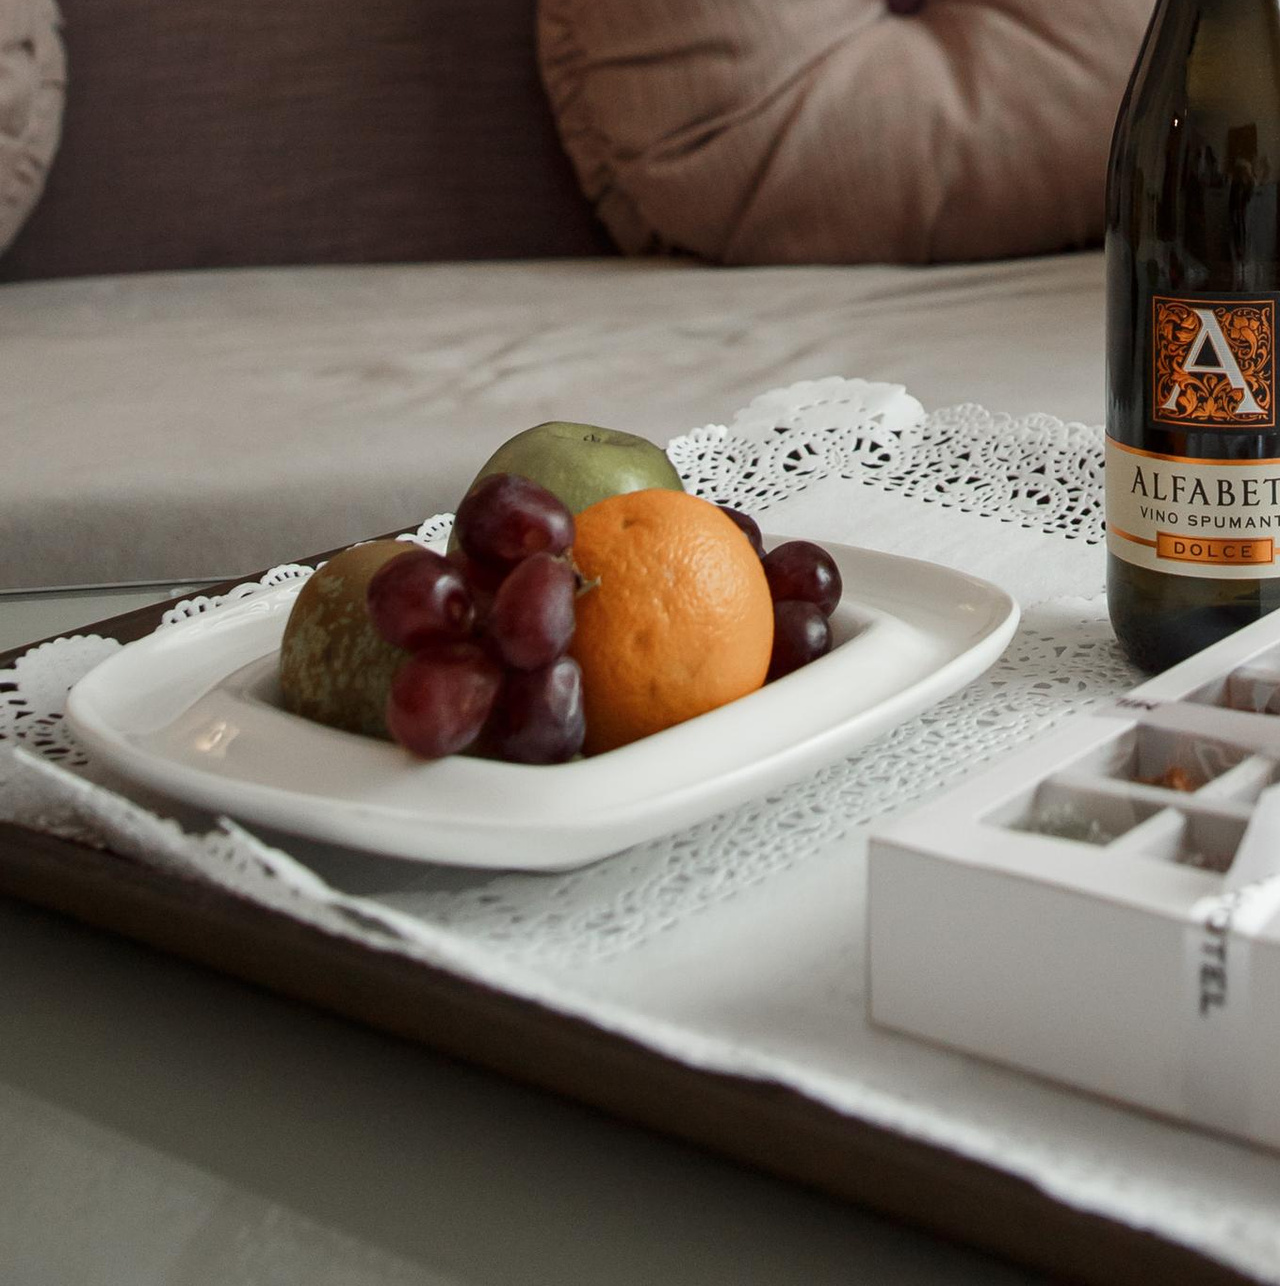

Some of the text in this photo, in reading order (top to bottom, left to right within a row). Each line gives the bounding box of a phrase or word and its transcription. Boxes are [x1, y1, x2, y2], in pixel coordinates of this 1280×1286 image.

[1160, 308, 1268, 414] A
[1139, 505, 1179, 525] VINO
[1173, 541, 1253, 559] DOLCE
